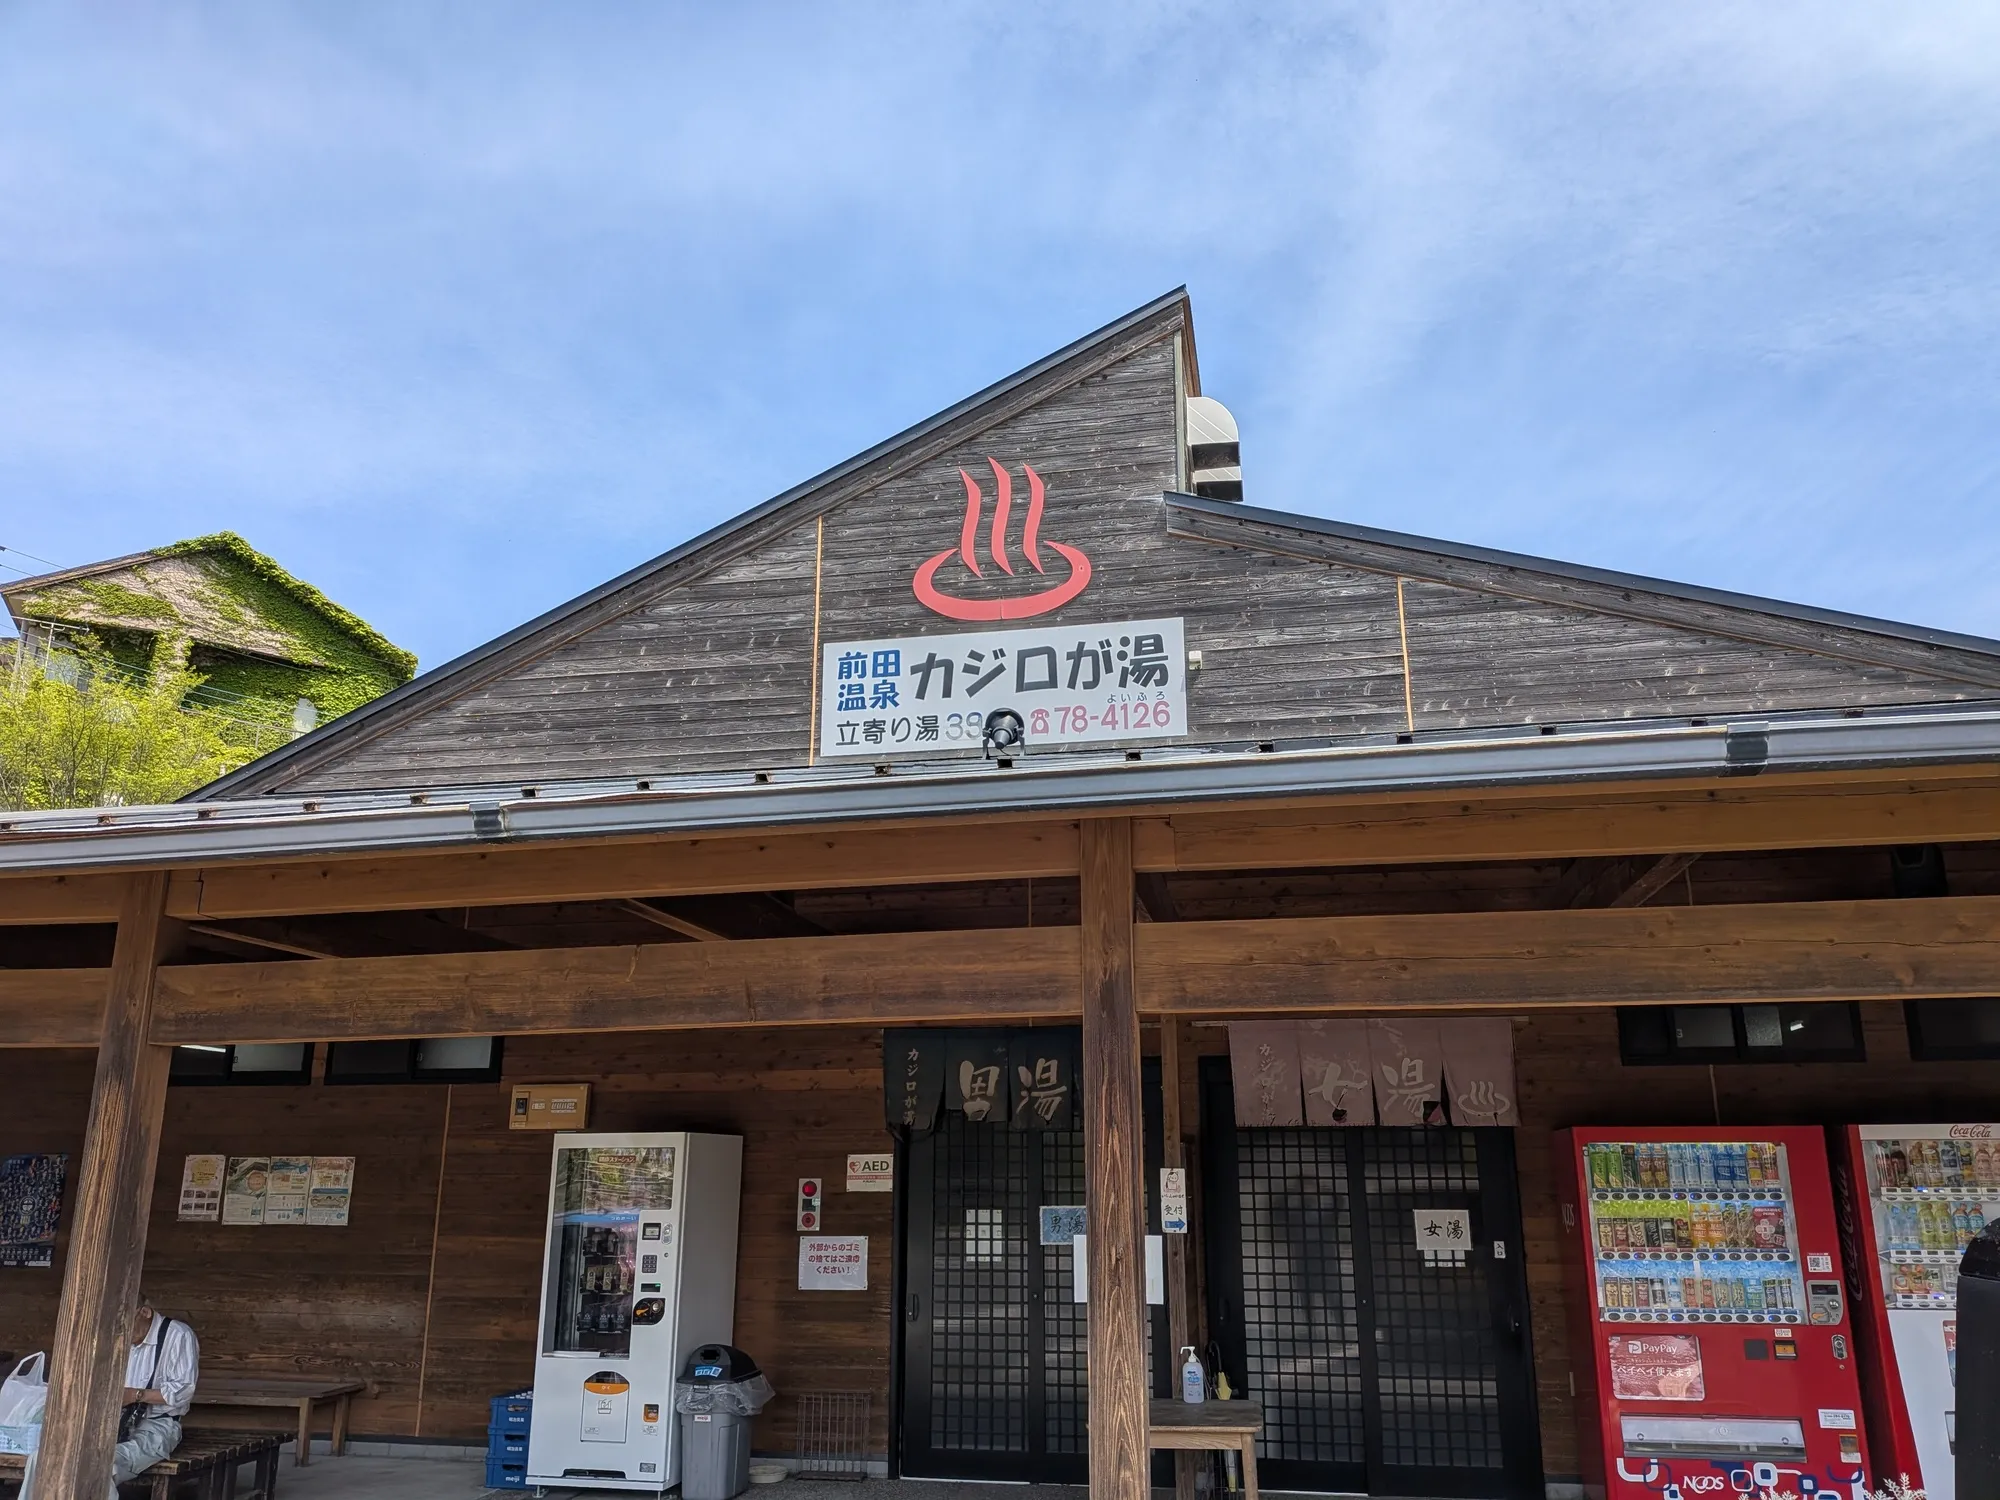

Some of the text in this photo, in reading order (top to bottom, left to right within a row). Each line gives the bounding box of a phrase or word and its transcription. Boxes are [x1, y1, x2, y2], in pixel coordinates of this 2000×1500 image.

[837, 649, 901, 680] 前田
[910, 633, 1169, 700] カジロが湯
[837, 681, 901, 712] 温泉
[1107, 692, 1166, 703] よいふろ
[1054, 700, 1171, 735] 78-4126
[835, 714, 940, 747] 立寄り湯
[959, 1058, 1067, 1121] 男湯
[1309, 1057, 1435, 1118] 女湯
[861, 1160, 889, 1172] AED
[1165, 1204, 1183, 1216] 受付
[1050, 1215, 1084, 1233] 男湯
[1424, 1219, 1464, 1240] 女湯
[808, 1243, 860, 1252] 外部からのゴミ
[1643, 1343, 1677, 1354] PayPay
[1616, 1366, 1693, 1377] ペイペイ使えます
